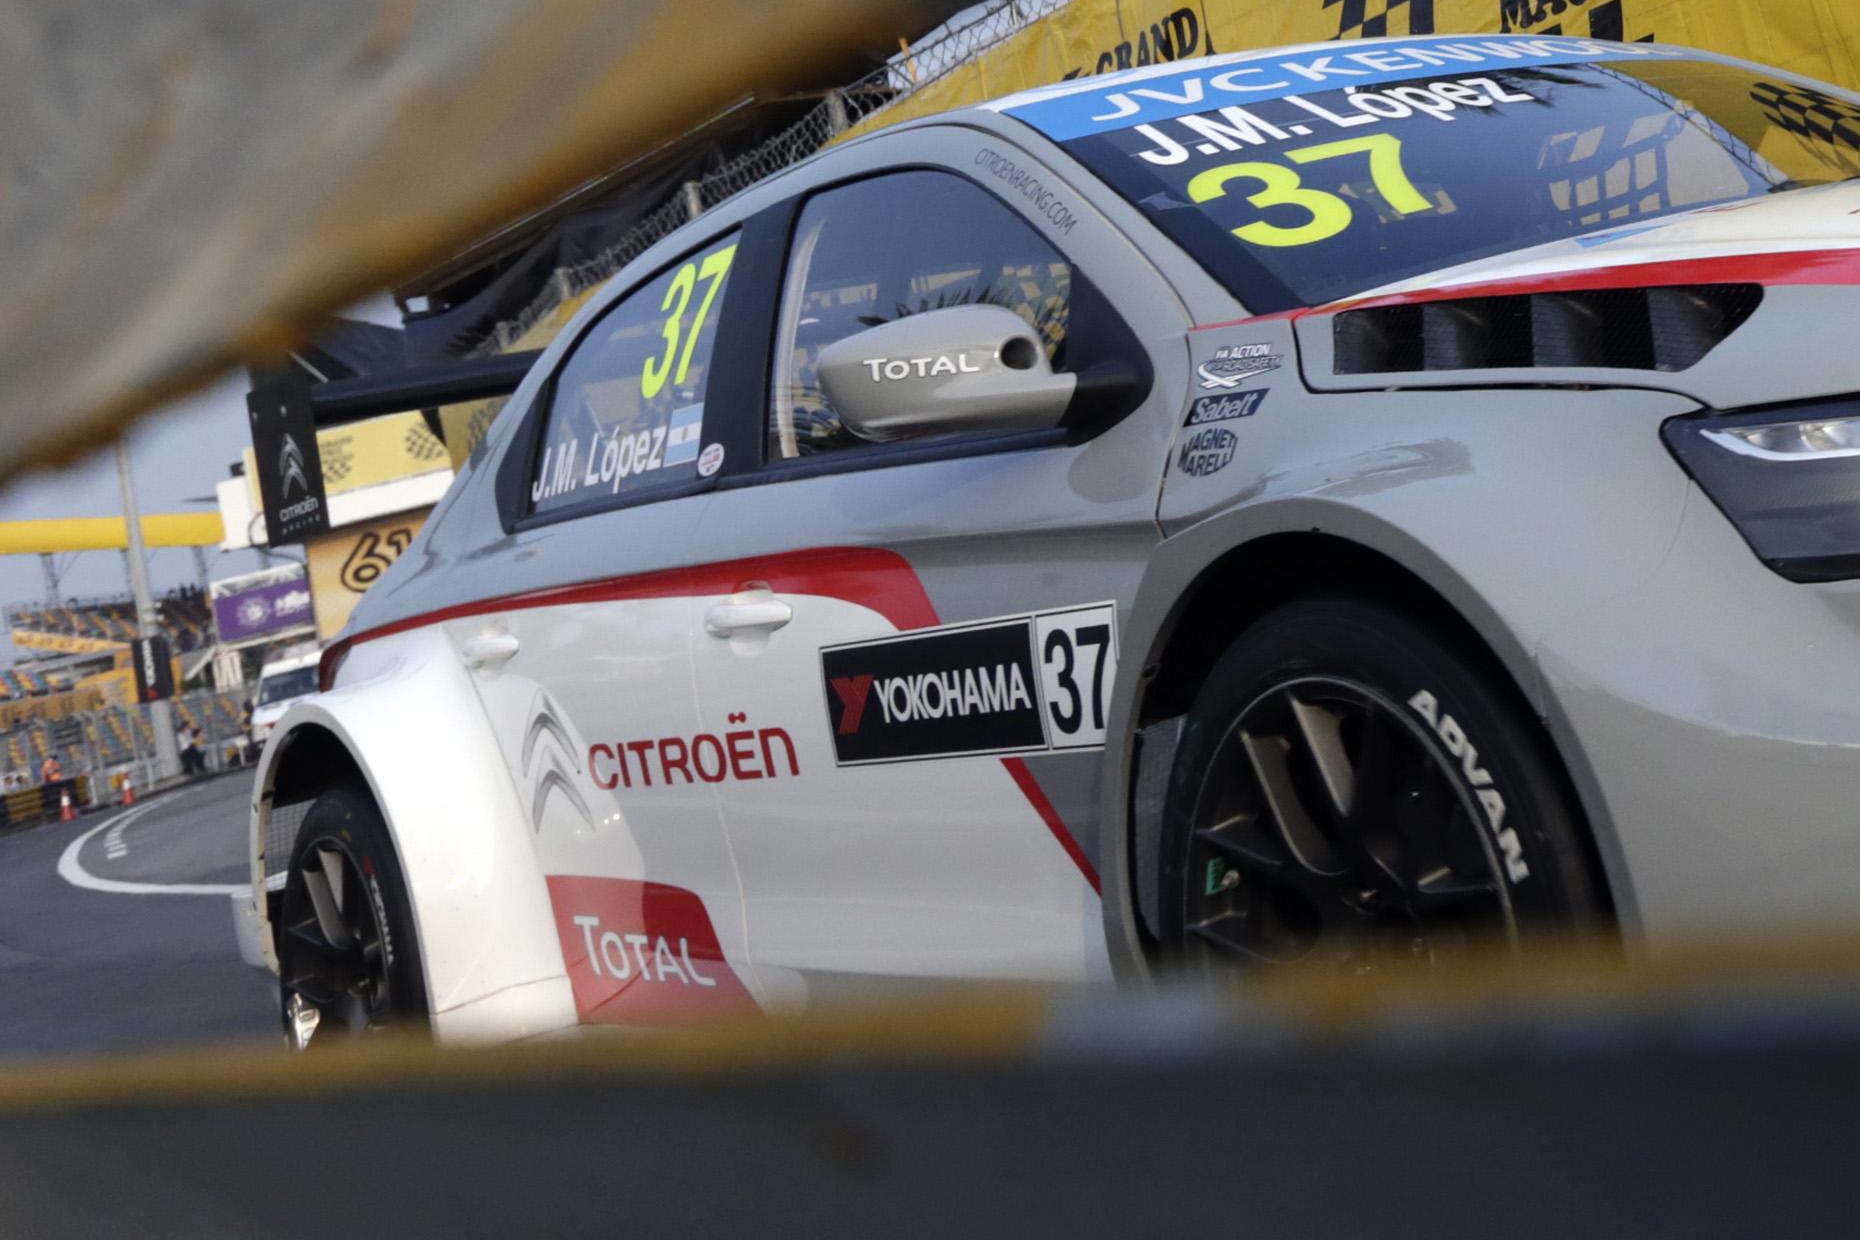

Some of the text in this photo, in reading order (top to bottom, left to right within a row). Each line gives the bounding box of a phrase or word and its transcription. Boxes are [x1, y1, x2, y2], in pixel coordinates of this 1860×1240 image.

[1133, 77, 1534, 165] J.M. López
[974, 148, 1078, 236] CITROENRACING.COM
[1187, 133, 1433, 247] 37
[641, 242, 739, 400] 37
[862, 353, 981, 383] TOTAL
[1191, 393, 1258, 424] Sabelt
[531, 439, 579, 503] J.M.
[584, 426, 667, 495] López
[873, 662, 1032, 724] YOKOHAMA
[1044, 623, 1110, 734] 37
[588, 711, 800, 791] CITROËN
[1407, 690, 1530, 885] ADVAN
[573, 915, 717, 987] TOTAL
